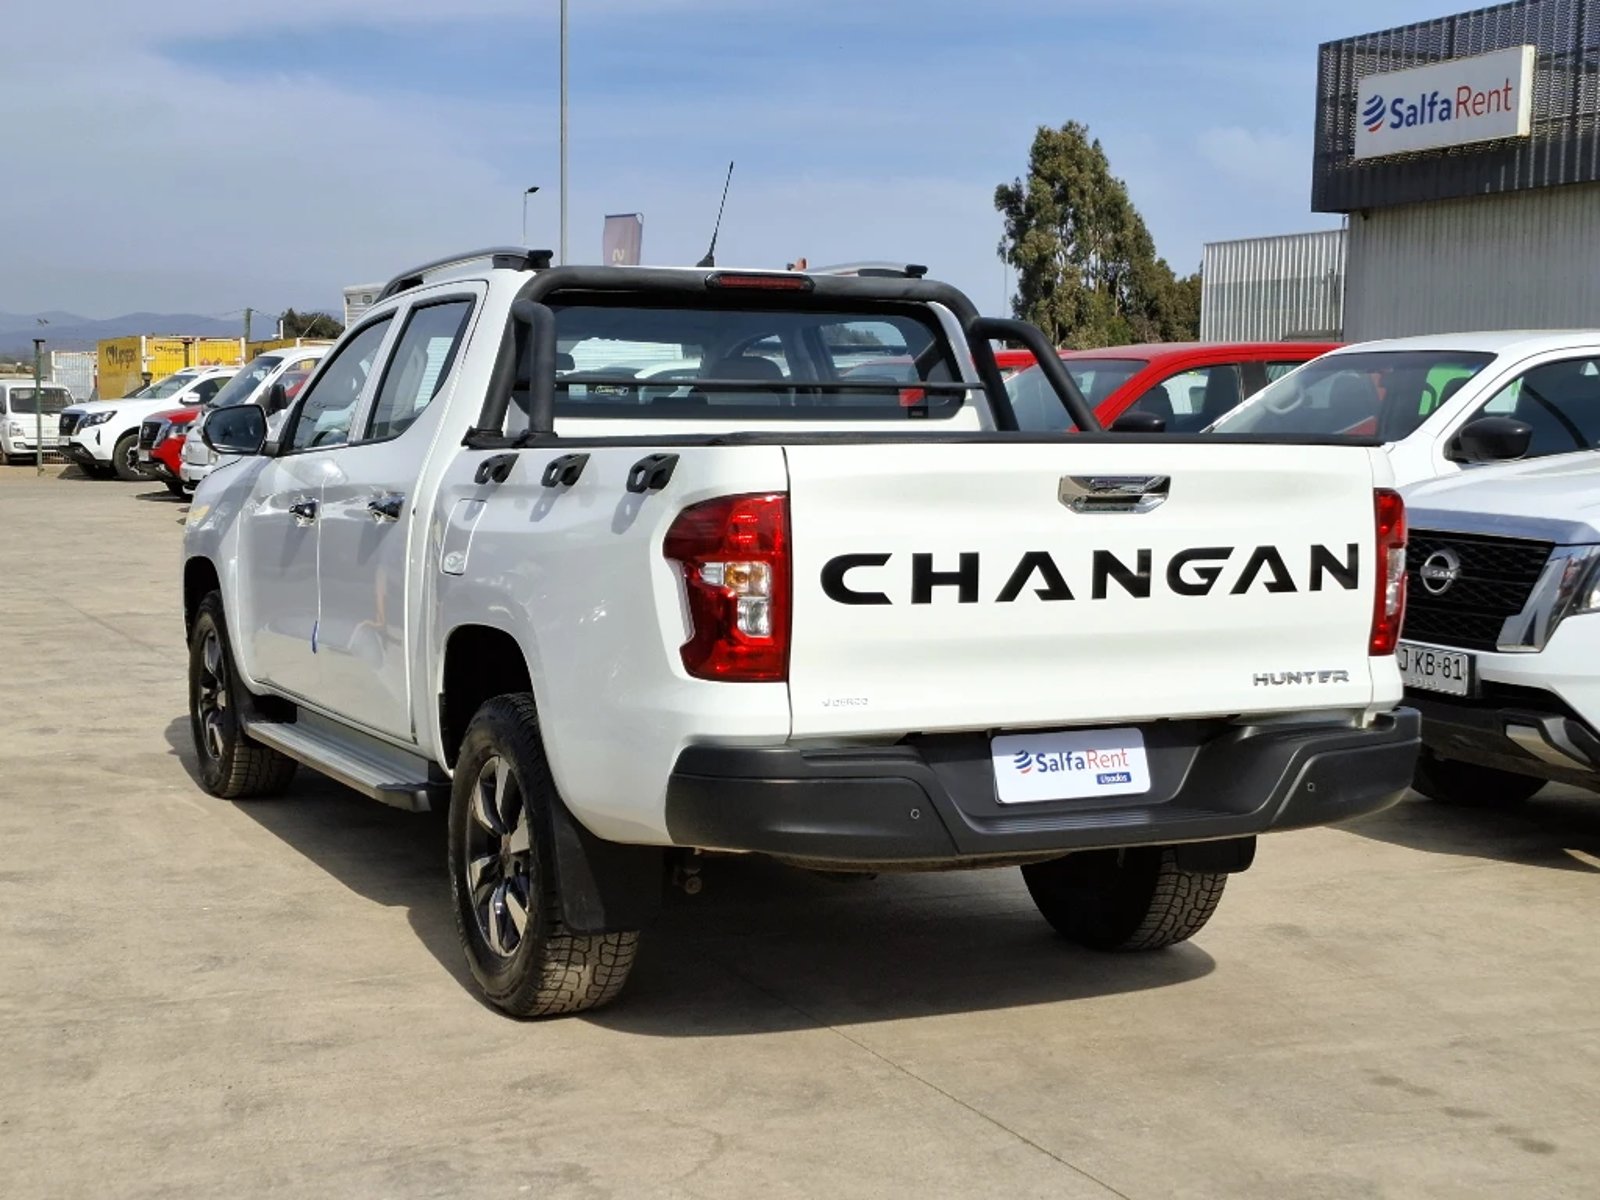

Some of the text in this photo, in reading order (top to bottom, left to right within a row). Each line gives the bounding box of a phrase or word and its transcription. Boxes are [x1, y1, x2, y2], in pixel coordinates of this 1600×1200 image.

[1389, 78, 1512, 129] SalfaRent
[820, 542, 1360, 605] CHANGAN
[1253, 670, 1349, 686] HUNTER
[1036, 748, 1129, 773] SalfaRent
